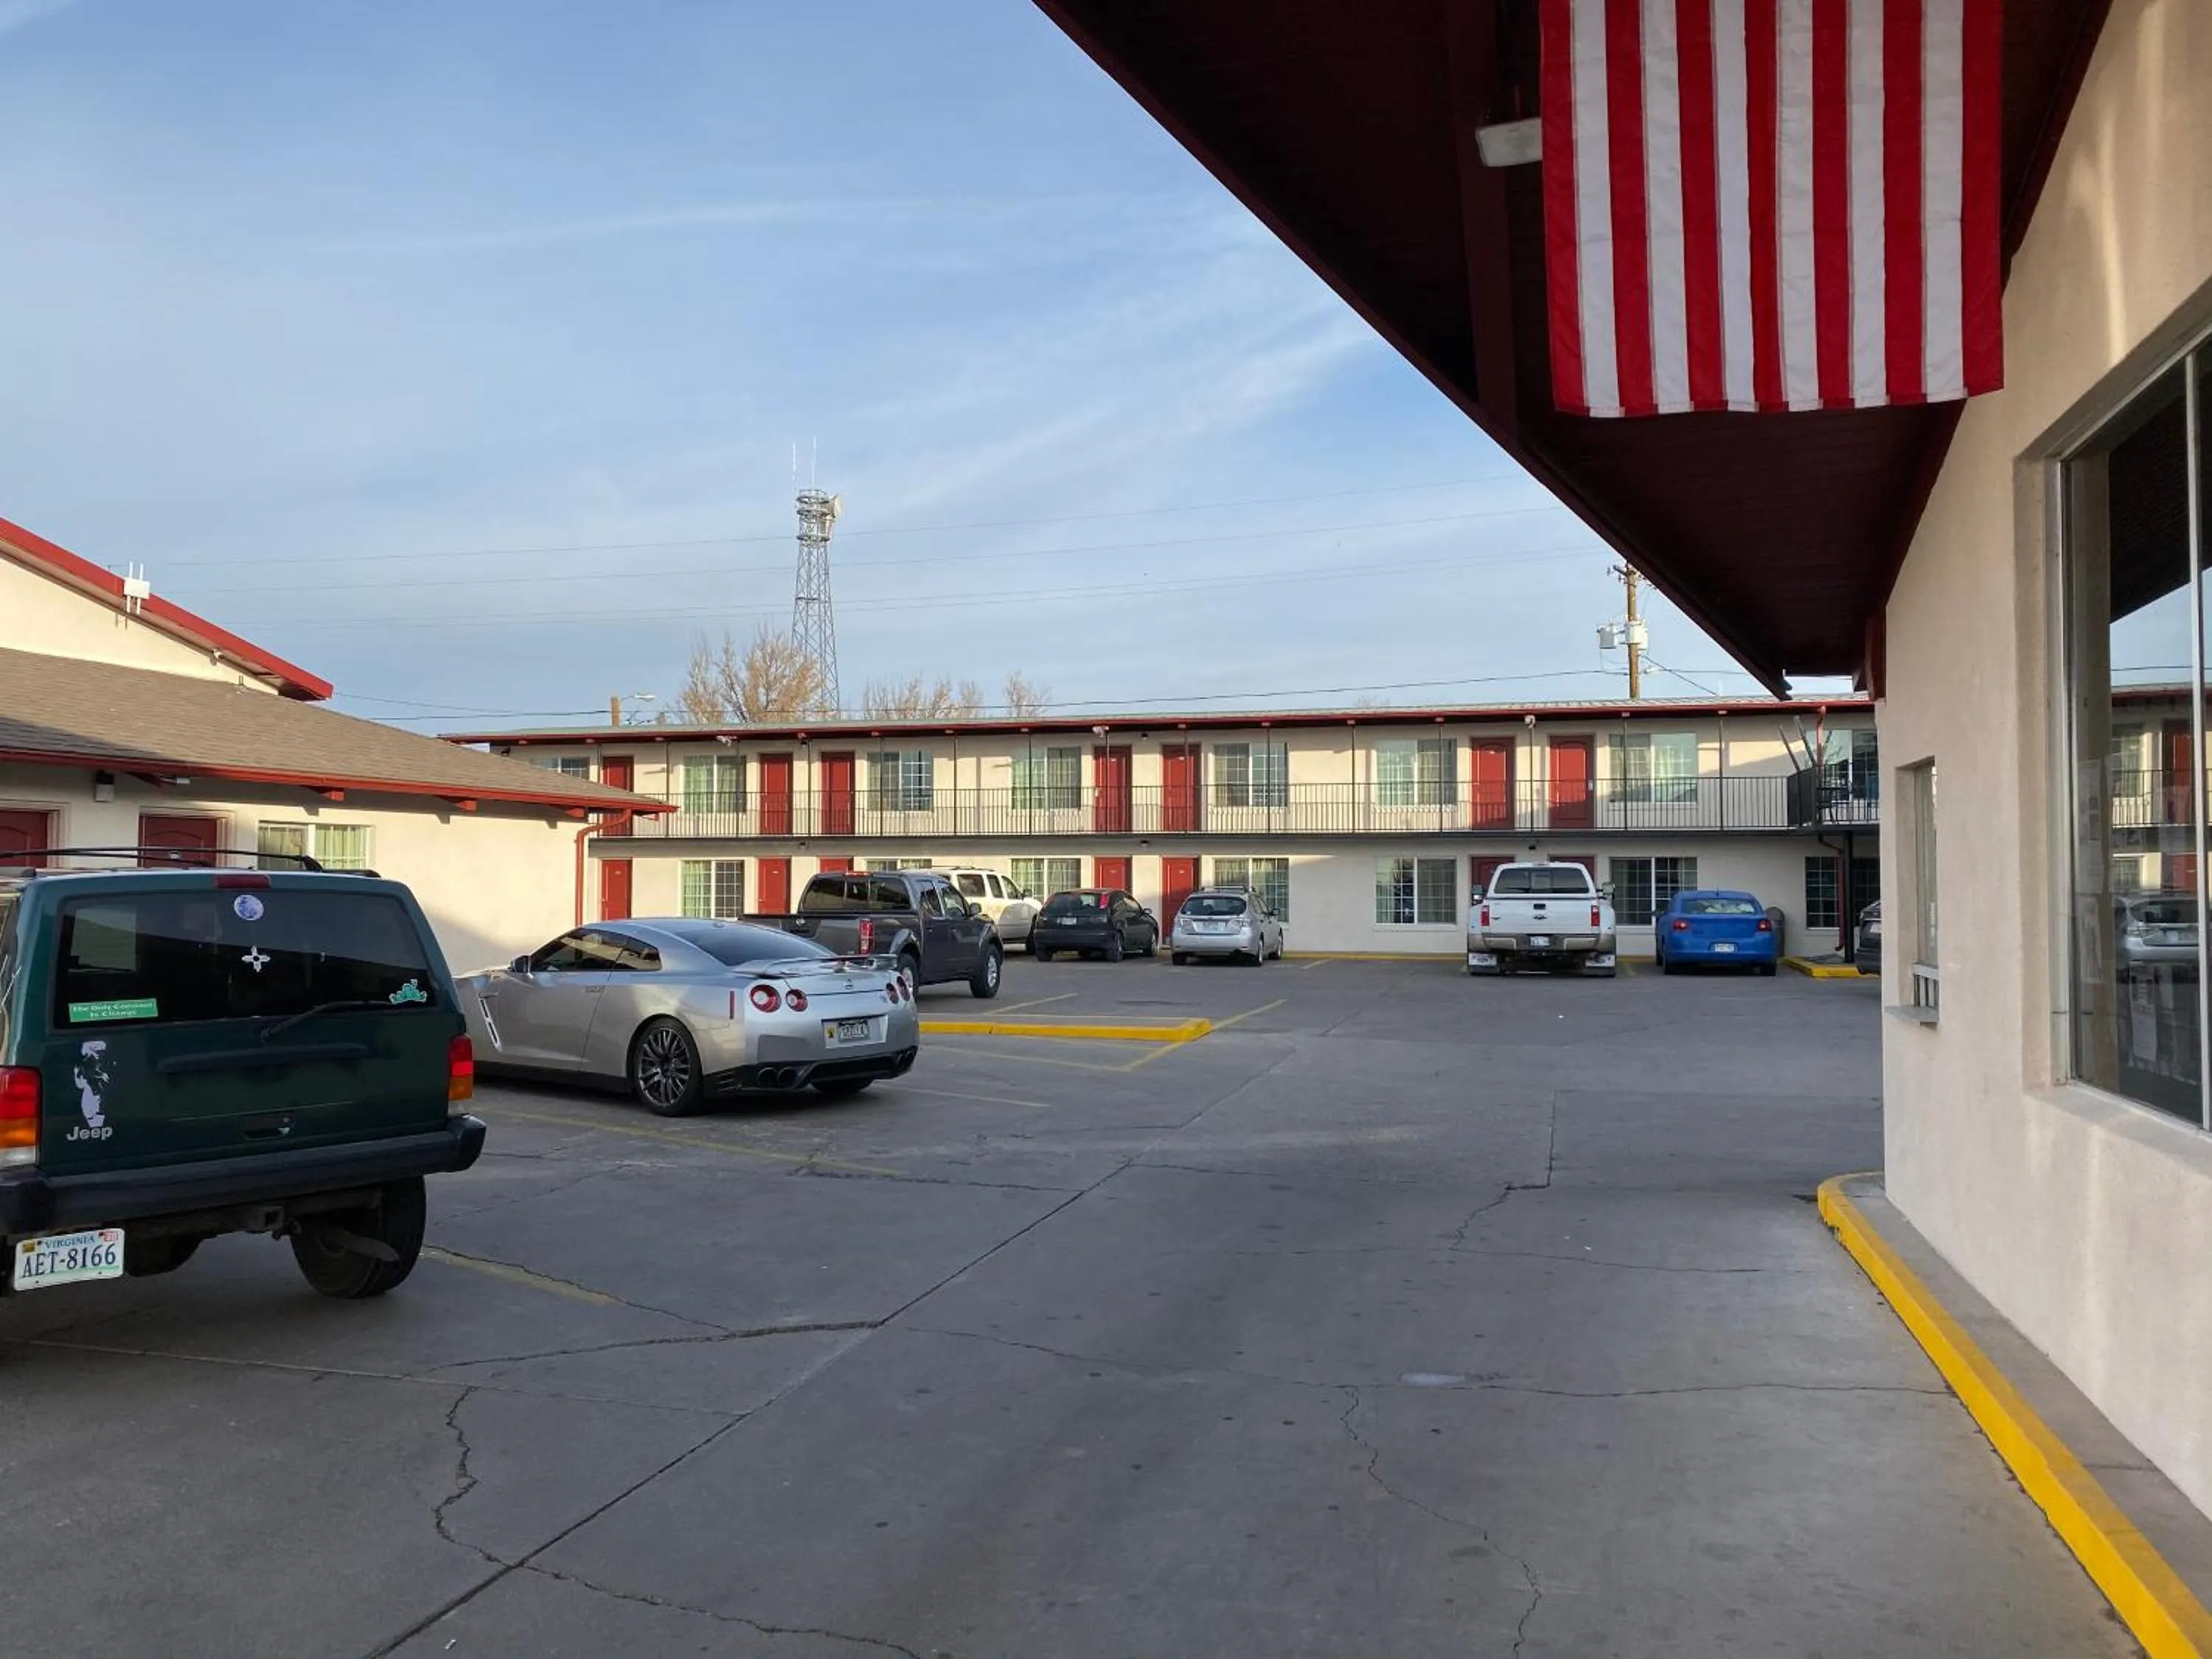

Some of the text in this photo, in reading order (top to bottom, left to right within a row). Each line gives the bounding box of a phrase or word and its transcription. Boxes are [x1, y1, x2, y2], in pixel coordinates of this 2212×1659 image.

[66, 1126, 113, 1141] Jeep
[45, 1235, 95, 1248] VIRGINIA
[22, 1243, 116, 1278] AET-8166
